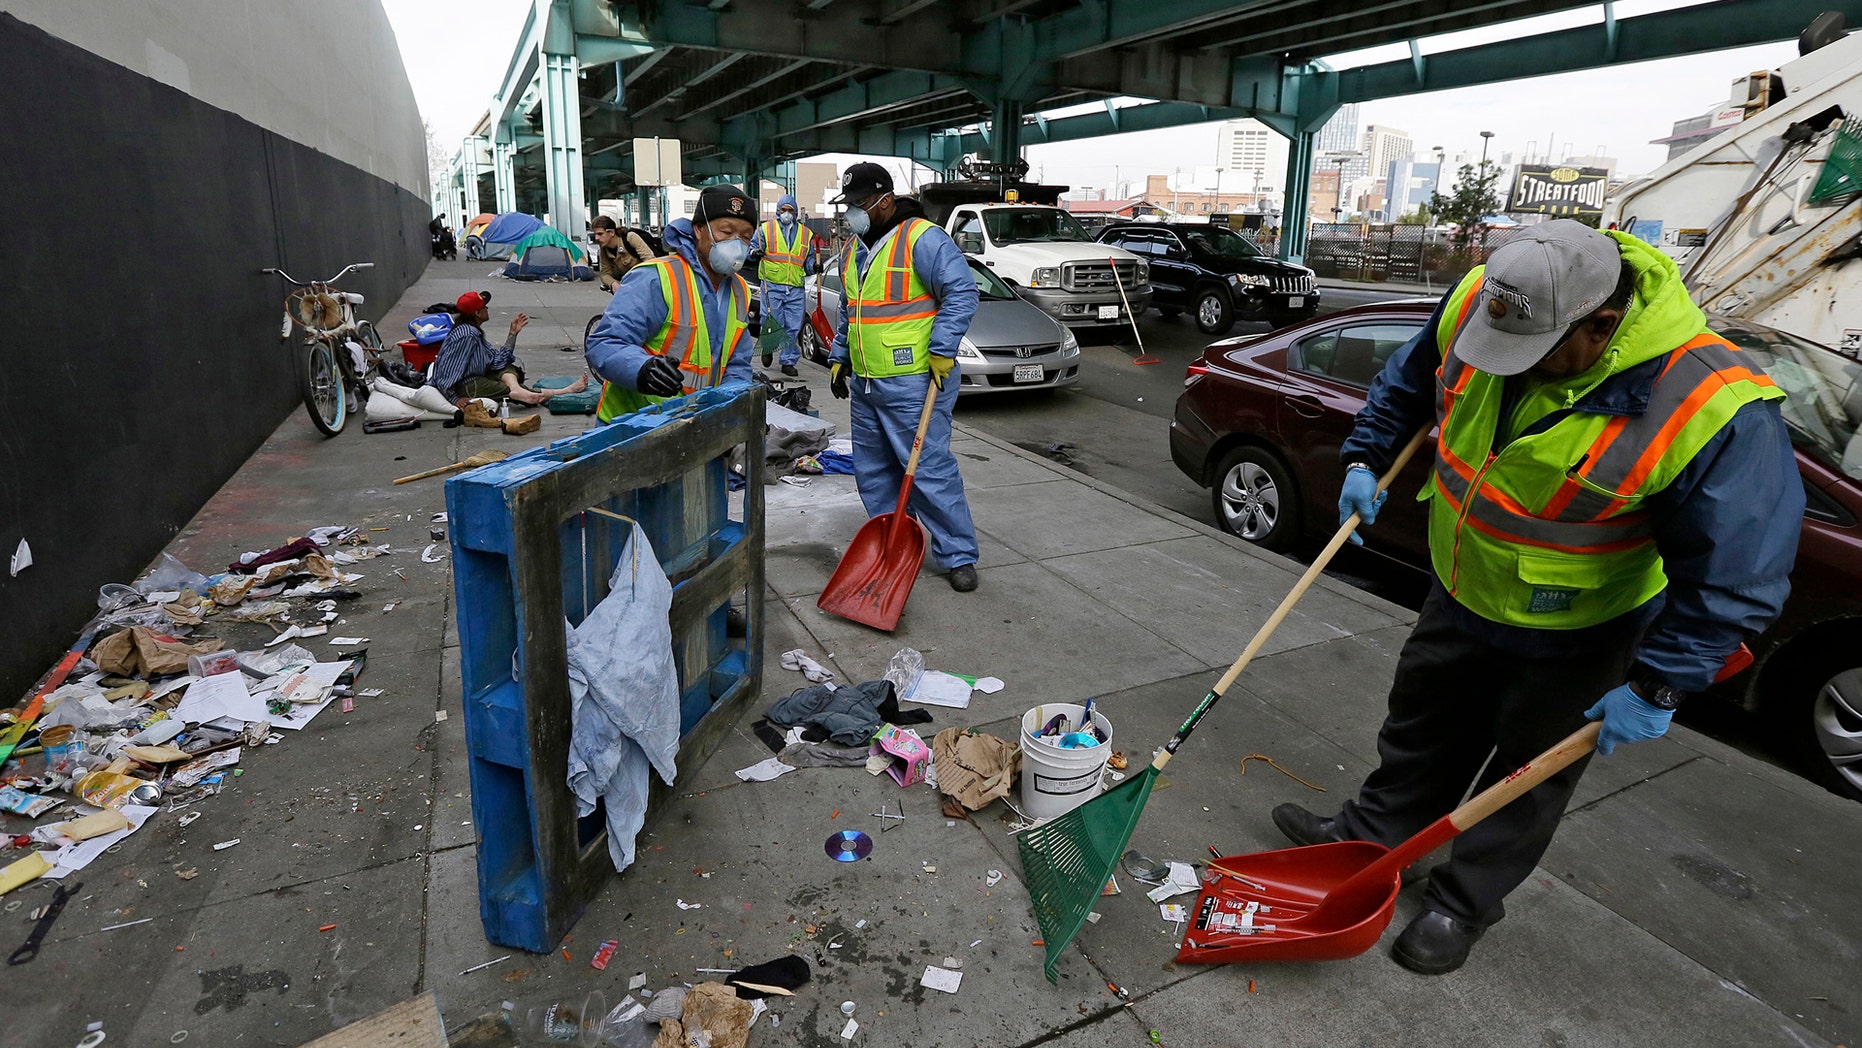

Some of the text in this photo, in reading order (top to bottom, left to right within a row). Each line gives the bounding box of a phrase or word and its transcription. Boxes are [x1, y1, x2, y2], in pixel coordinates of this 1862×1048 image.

[1553, 168, 1577, 182] SOMA
[1517, 174, 1606, 210] STREATFOOD
[1538, 204, 1581, 215] PARK
